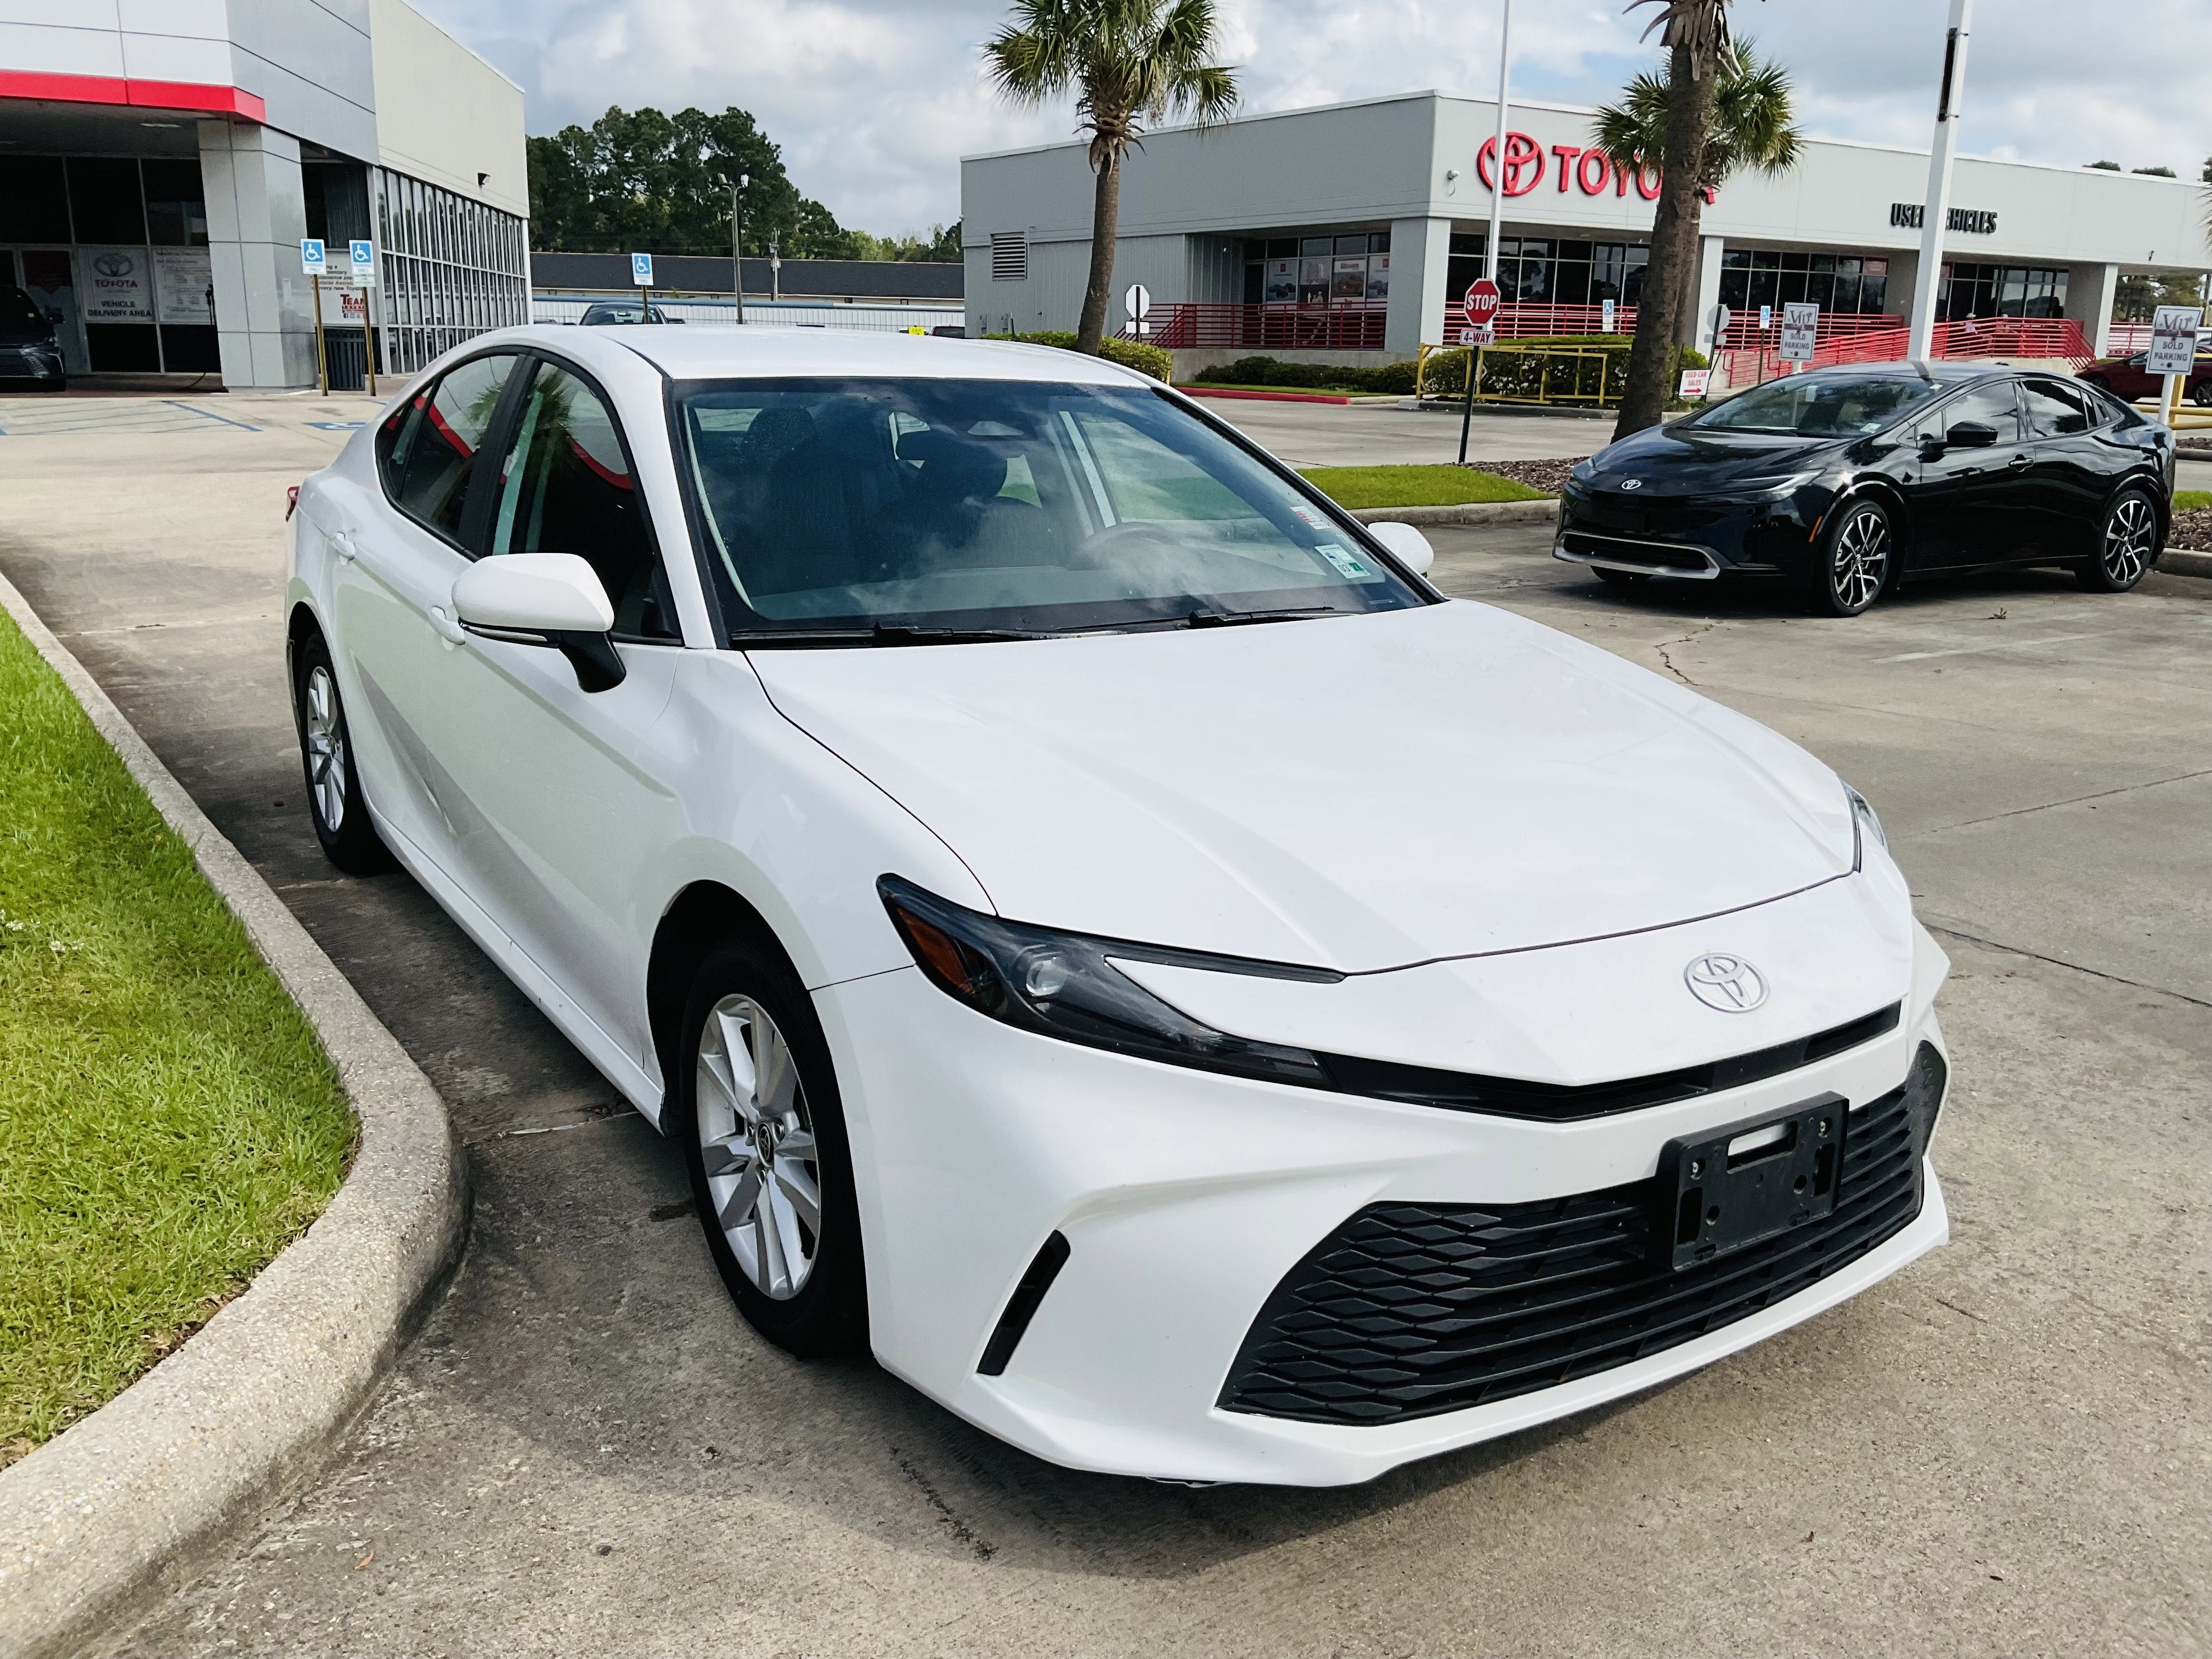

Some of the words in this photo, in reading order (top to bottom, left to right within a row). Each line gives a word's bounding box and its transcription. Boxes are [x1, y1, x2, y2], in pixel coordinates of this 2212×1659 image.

[1891, 202, 1925, 228] USE
[1945, 207, 1997, 233] EHICLES
[95, 279, 138, 288] TOYOTA
[1467, 295, 1497, 311] STOP
[1464, 332, 1491, 343] 4-WAY
[1785, 341, 1809, 349] PARKING
[2163, 341, 2183, 350] SOLD
[2154, 352, 2188, 361] PARKING
